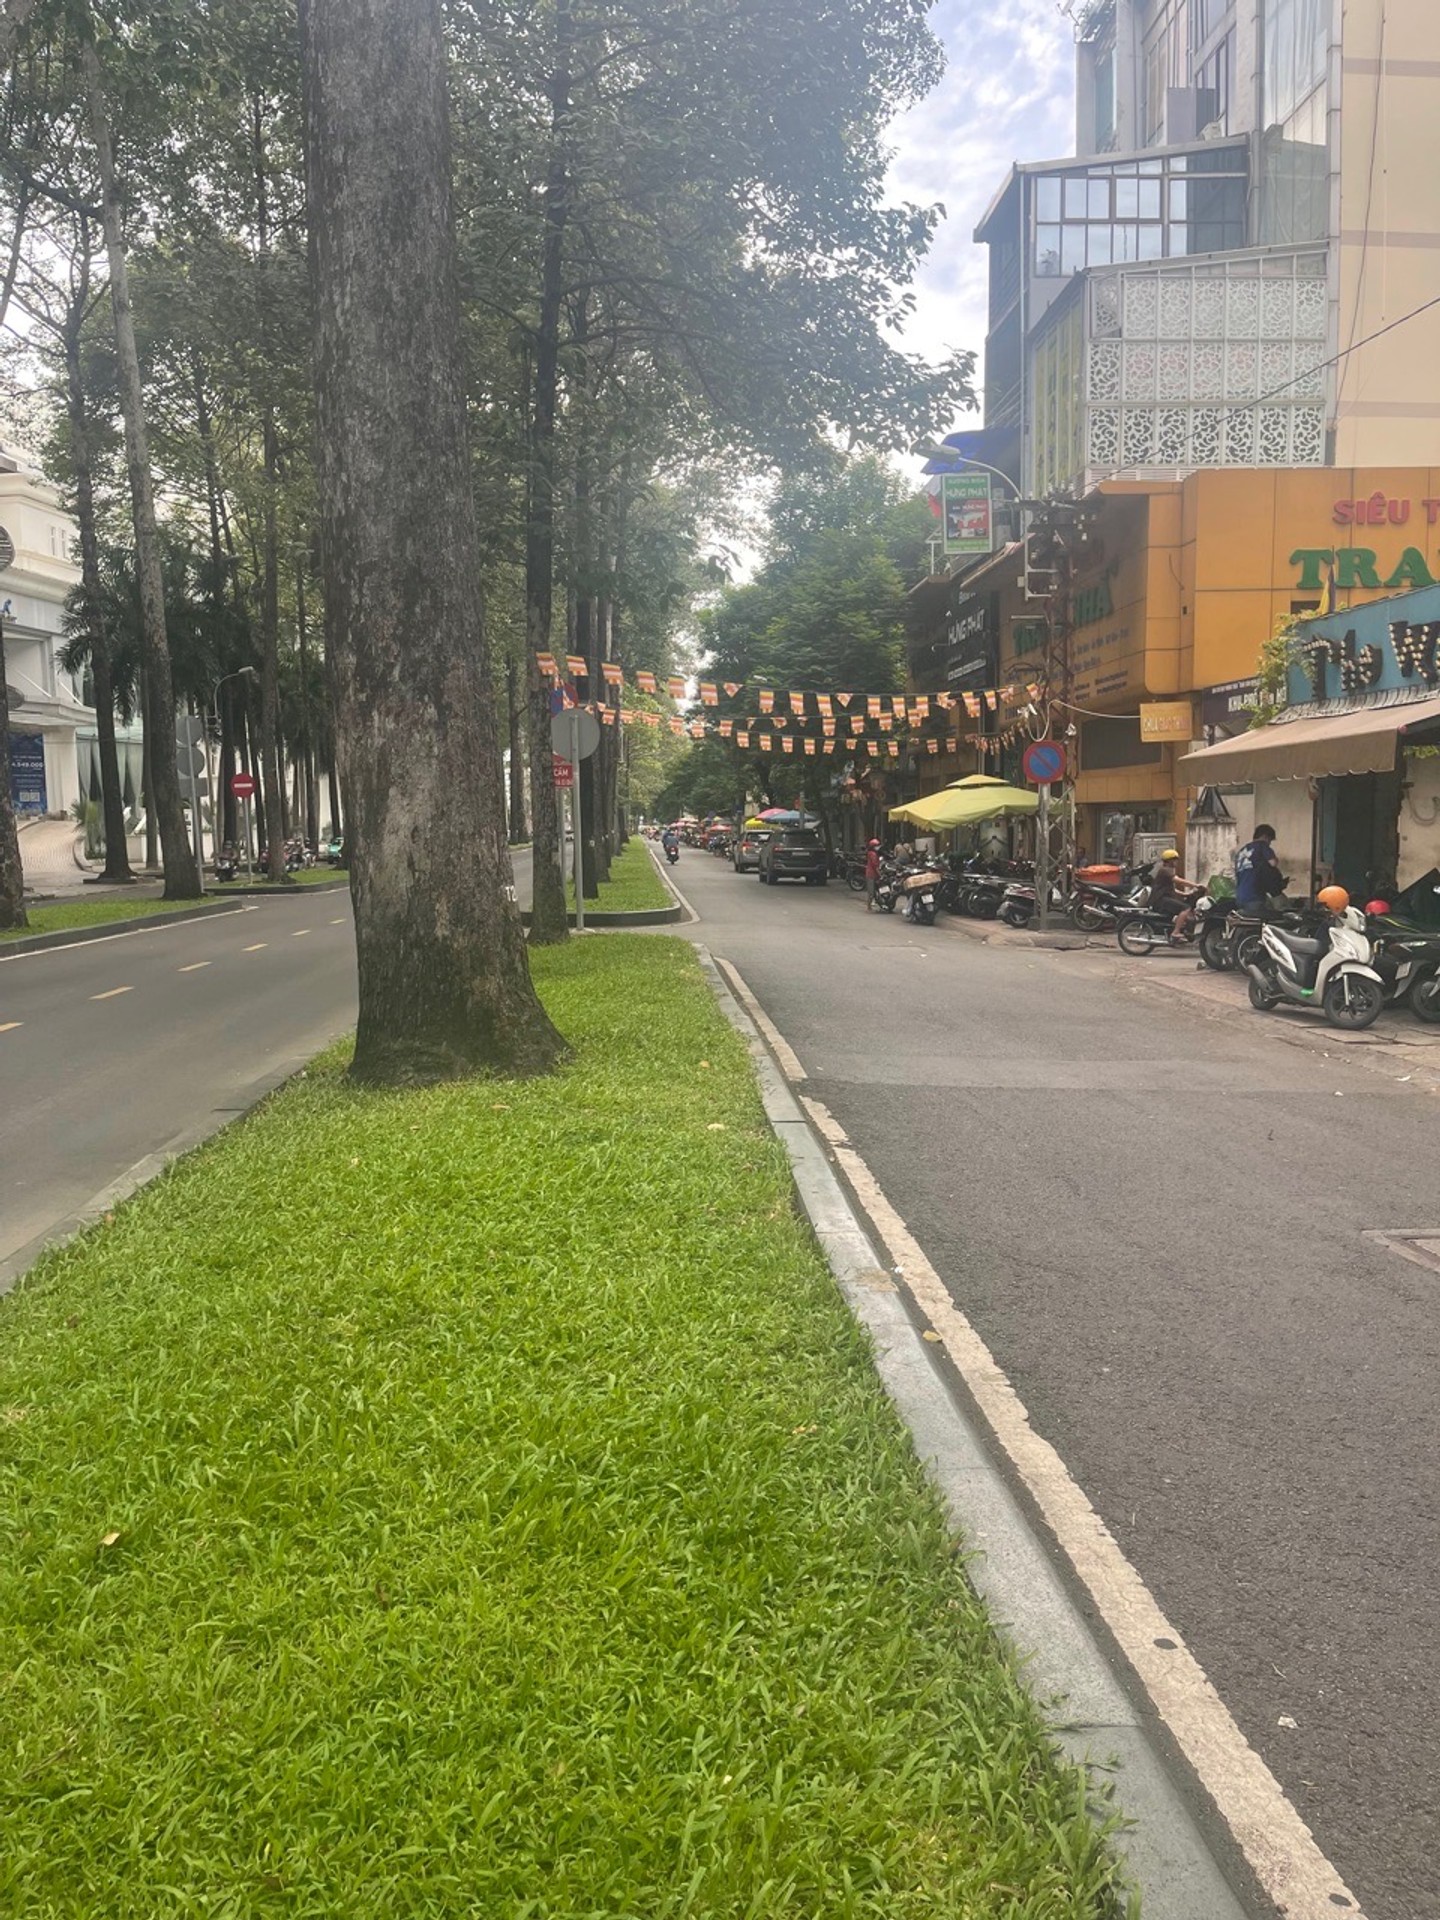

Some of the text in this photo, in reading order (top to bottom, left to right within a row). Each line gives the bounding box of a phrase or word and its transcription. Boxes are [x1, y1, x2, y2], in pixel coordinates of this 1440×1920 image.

[1332, 491, 1411, 525] SIÊU
[1289, 546, 1440, 590] TRA
[1388, 620, 1440, 684] W
